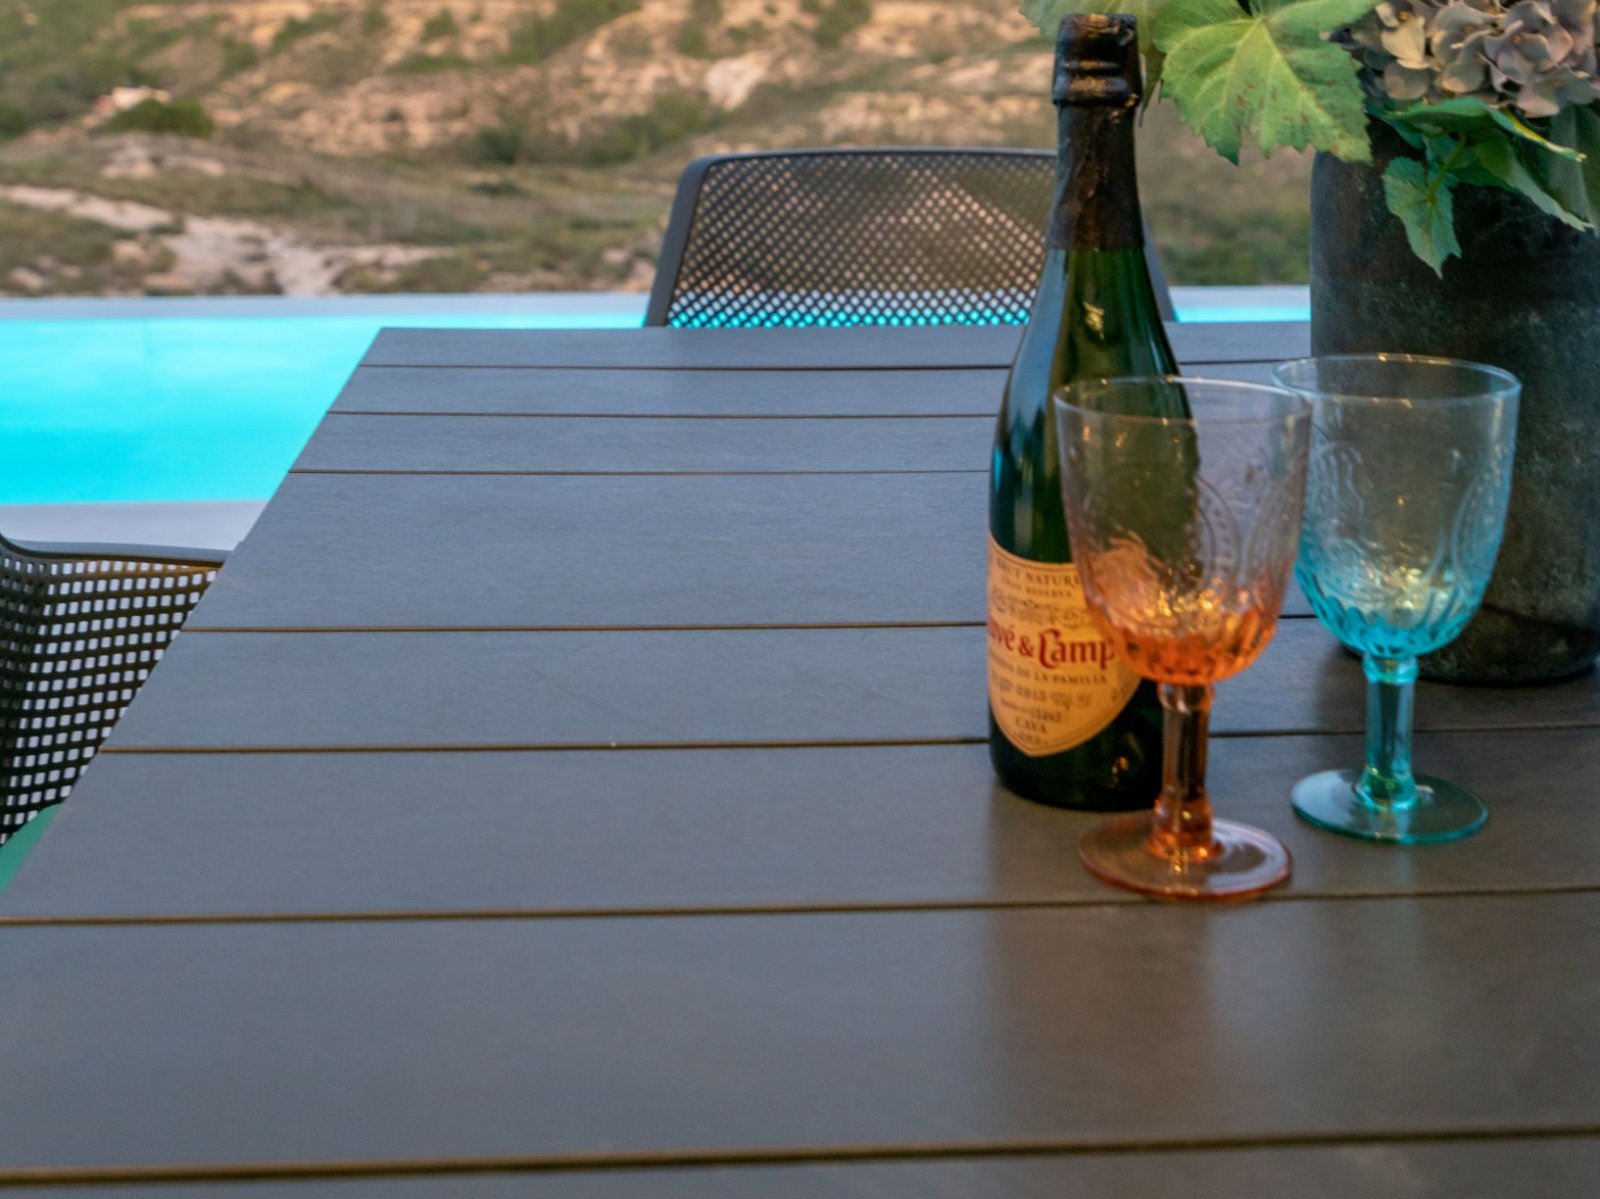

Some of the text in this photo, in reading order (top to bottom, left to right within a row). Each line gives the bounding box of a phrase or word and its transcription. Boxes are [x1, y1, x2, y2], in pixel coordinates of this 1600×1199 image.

[1018, 634, 1034, 658] &
[1039, 628, 1115, 670] Camp
[1034, 671, 1048, 682] LA
[1052, 674, 1107, 685] FAMILIA
[1015, 716, 1048, 734] CAVA
